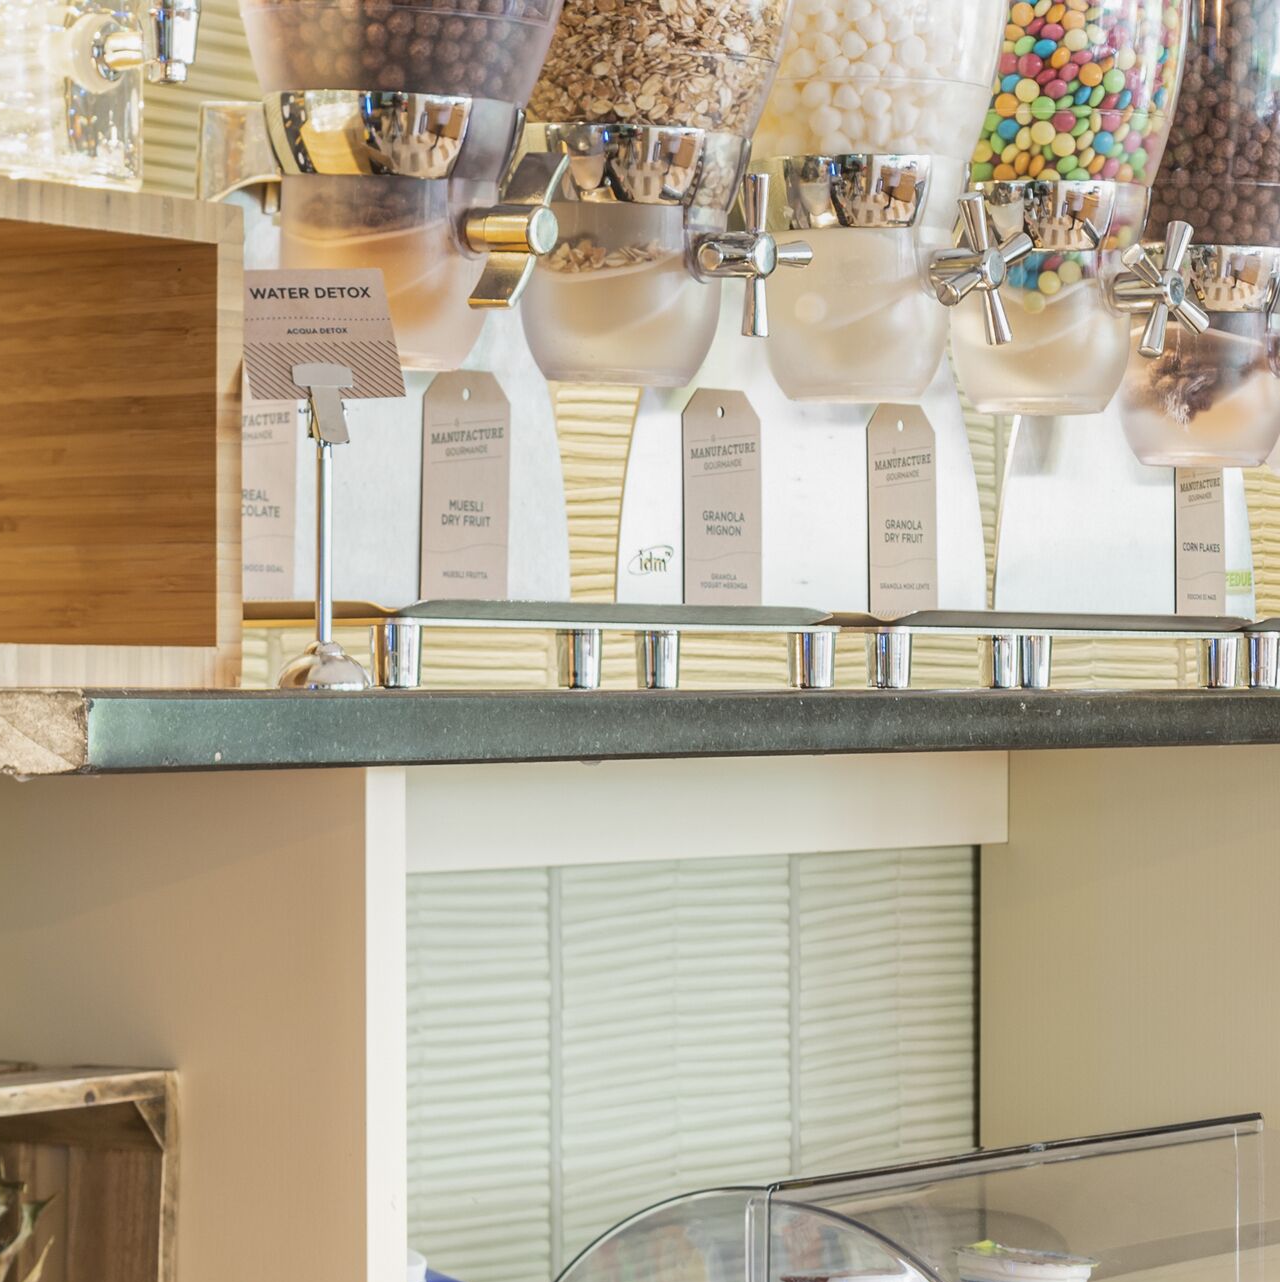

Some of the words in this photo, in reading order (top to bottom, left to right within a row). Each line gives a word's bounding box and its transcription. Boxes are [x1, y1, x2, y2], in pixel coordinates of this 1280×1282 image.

[249, 286, 310, 300] WATER
[314, 286, 371, 299] DETOX
[287, 327, 317, 335] ACQUA
[431, 427, 504, 444] MANUFACTURE
[445, 444, 488, 457] GOURMANDE
[690, 442, 755, 459] MANUFACTURE
[704, 458, 742, 470] GOURMANDE
[875, 453, 931, 471] MANUFACTURE
[886, 469, 920, 481] GOURMANDE
[1180, 478, 1220, 492] MANUFACTURE
[449, 499, 484, 512] MUESLI
[441, 514, 460, 526] DRY
[463, 516, 490, 527] FRUIT
[702, 510, 745, 522] GRANOLA
[706, 525, 741, 536] MIGNON
[885, 519, 922, 530] GRANOLA
[885, 533, 899, 543] DRY
[902, 534, 923, 544] FRUIT
[1183, 542, 1198, 552] CORN
[1199, 542, 1220, 553] FLAKES
